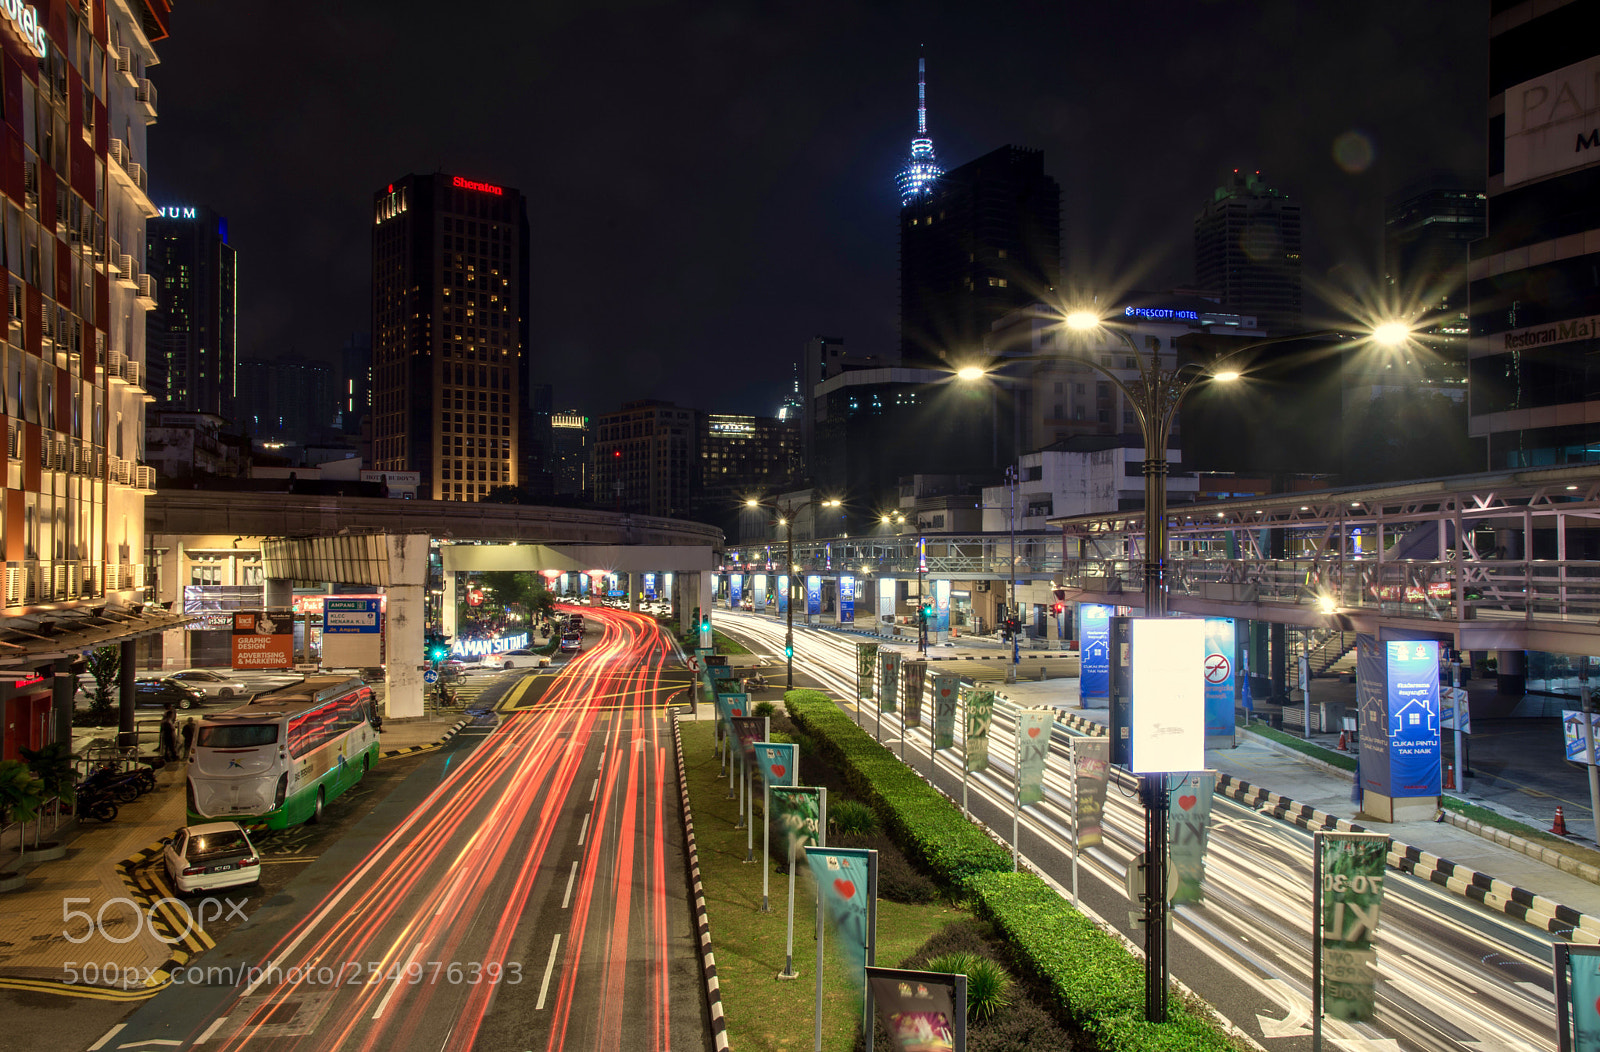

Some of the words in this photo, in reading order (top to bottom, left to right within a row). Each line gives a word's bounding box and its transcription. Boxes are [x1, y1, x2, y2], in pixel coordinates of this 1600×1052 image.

[453, 176, 502, 196] Sheraton
[1135, 308, 1173, 318] PRESCOTT
[1175, 310, 1198, 319] HOTEL
[1504, 328, 1556, 349] Restoran
[1557, 318, 1600, 341] Maj
[237, 651, 285, 659] ADVERTISING
[244, 657, 287, 665] MARKETING
